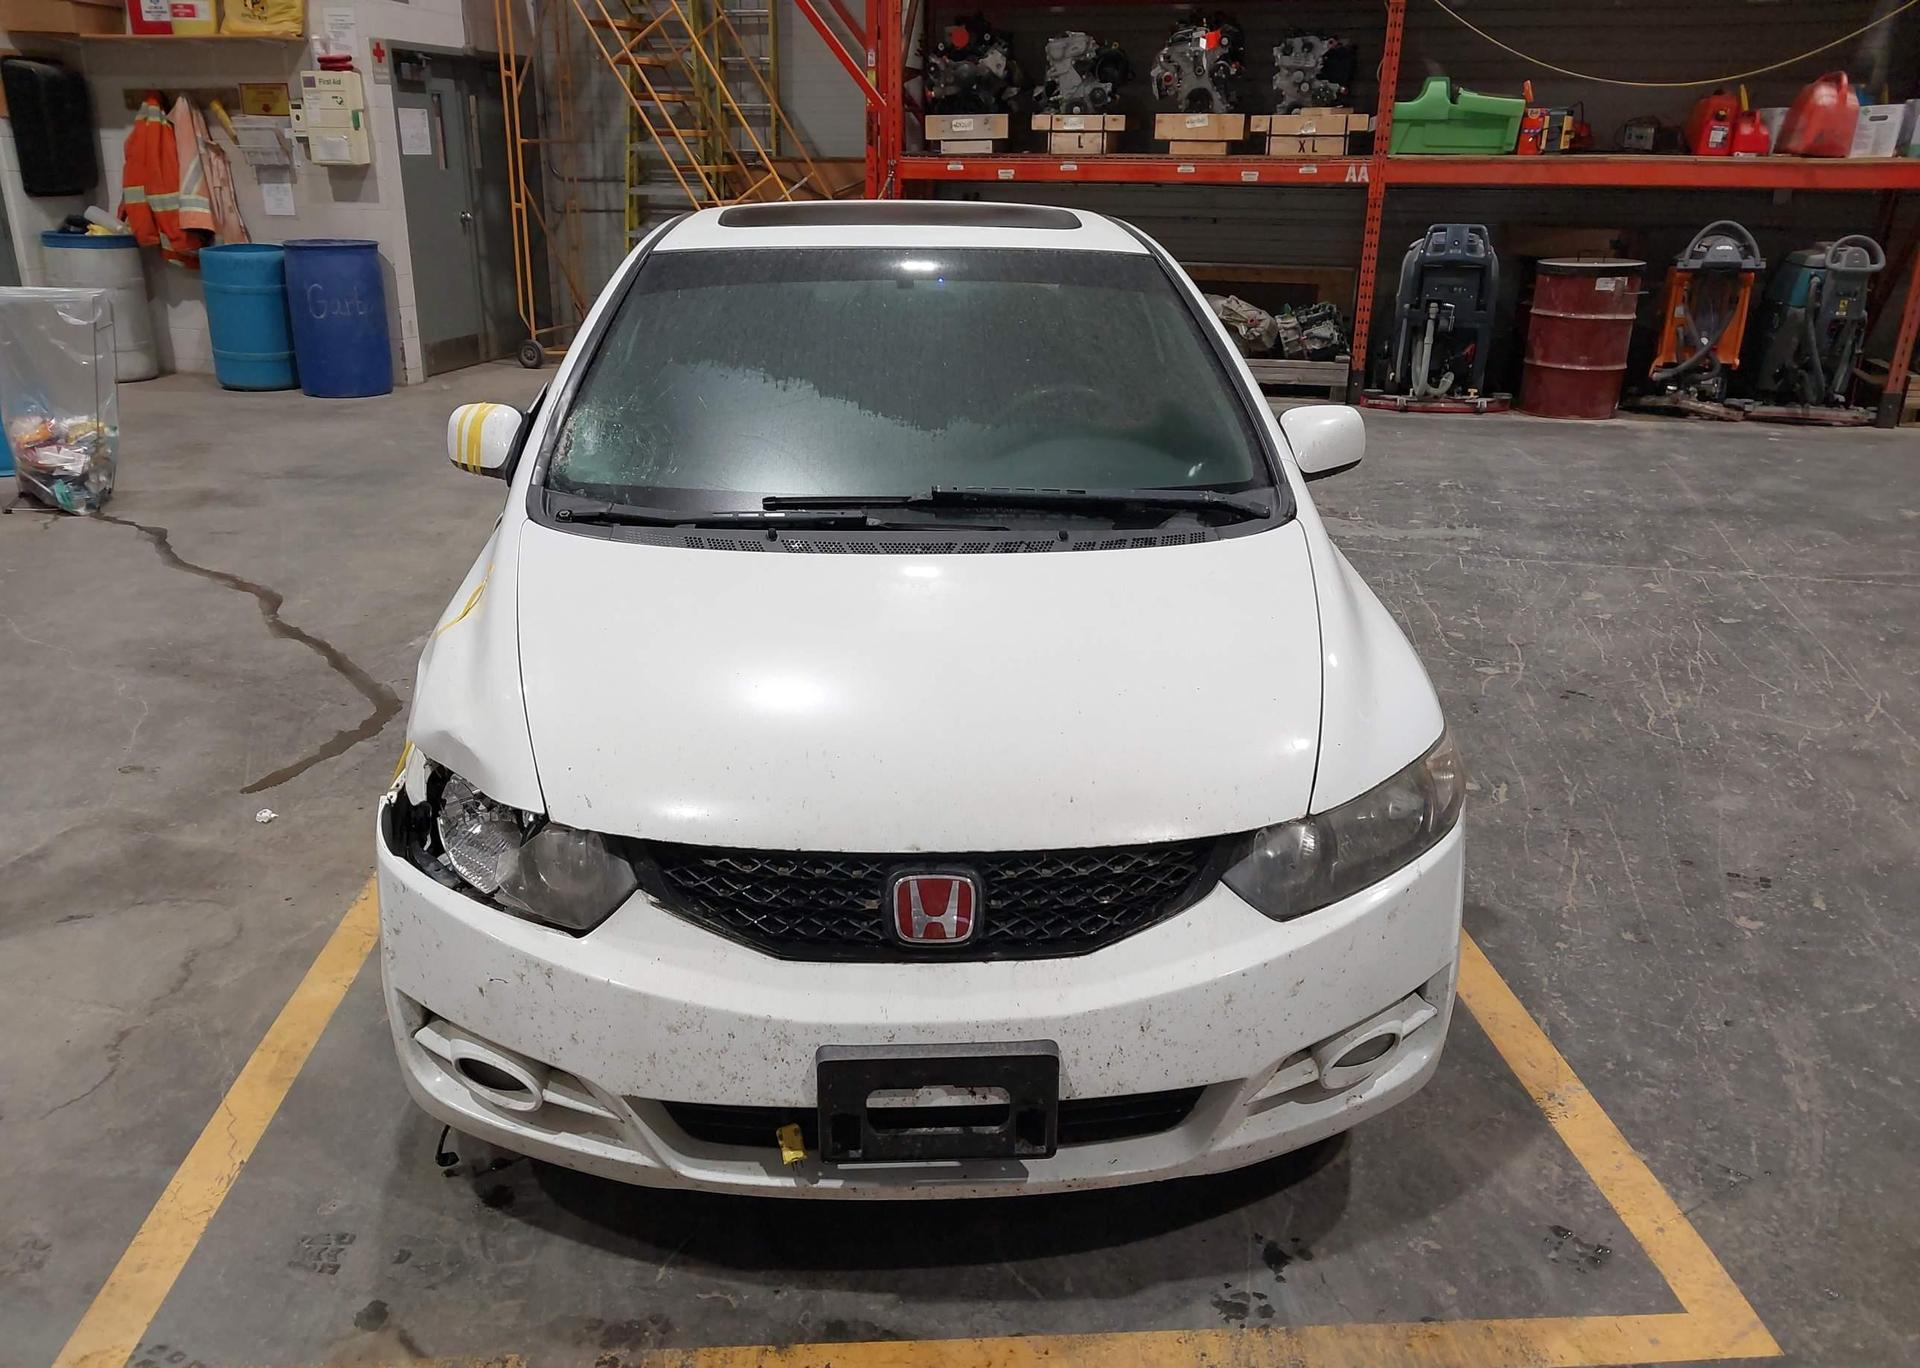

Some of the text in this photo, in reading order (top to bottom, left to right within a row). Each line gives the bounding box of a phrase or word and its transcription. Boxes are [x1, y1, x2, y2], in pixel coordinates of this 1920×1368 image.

[319, 78, 342, 86] First Aid
[1077, 135, 1085, 149] L
[1344, 164, 1369, 183] AA
[909, 880, 960, 938] H
